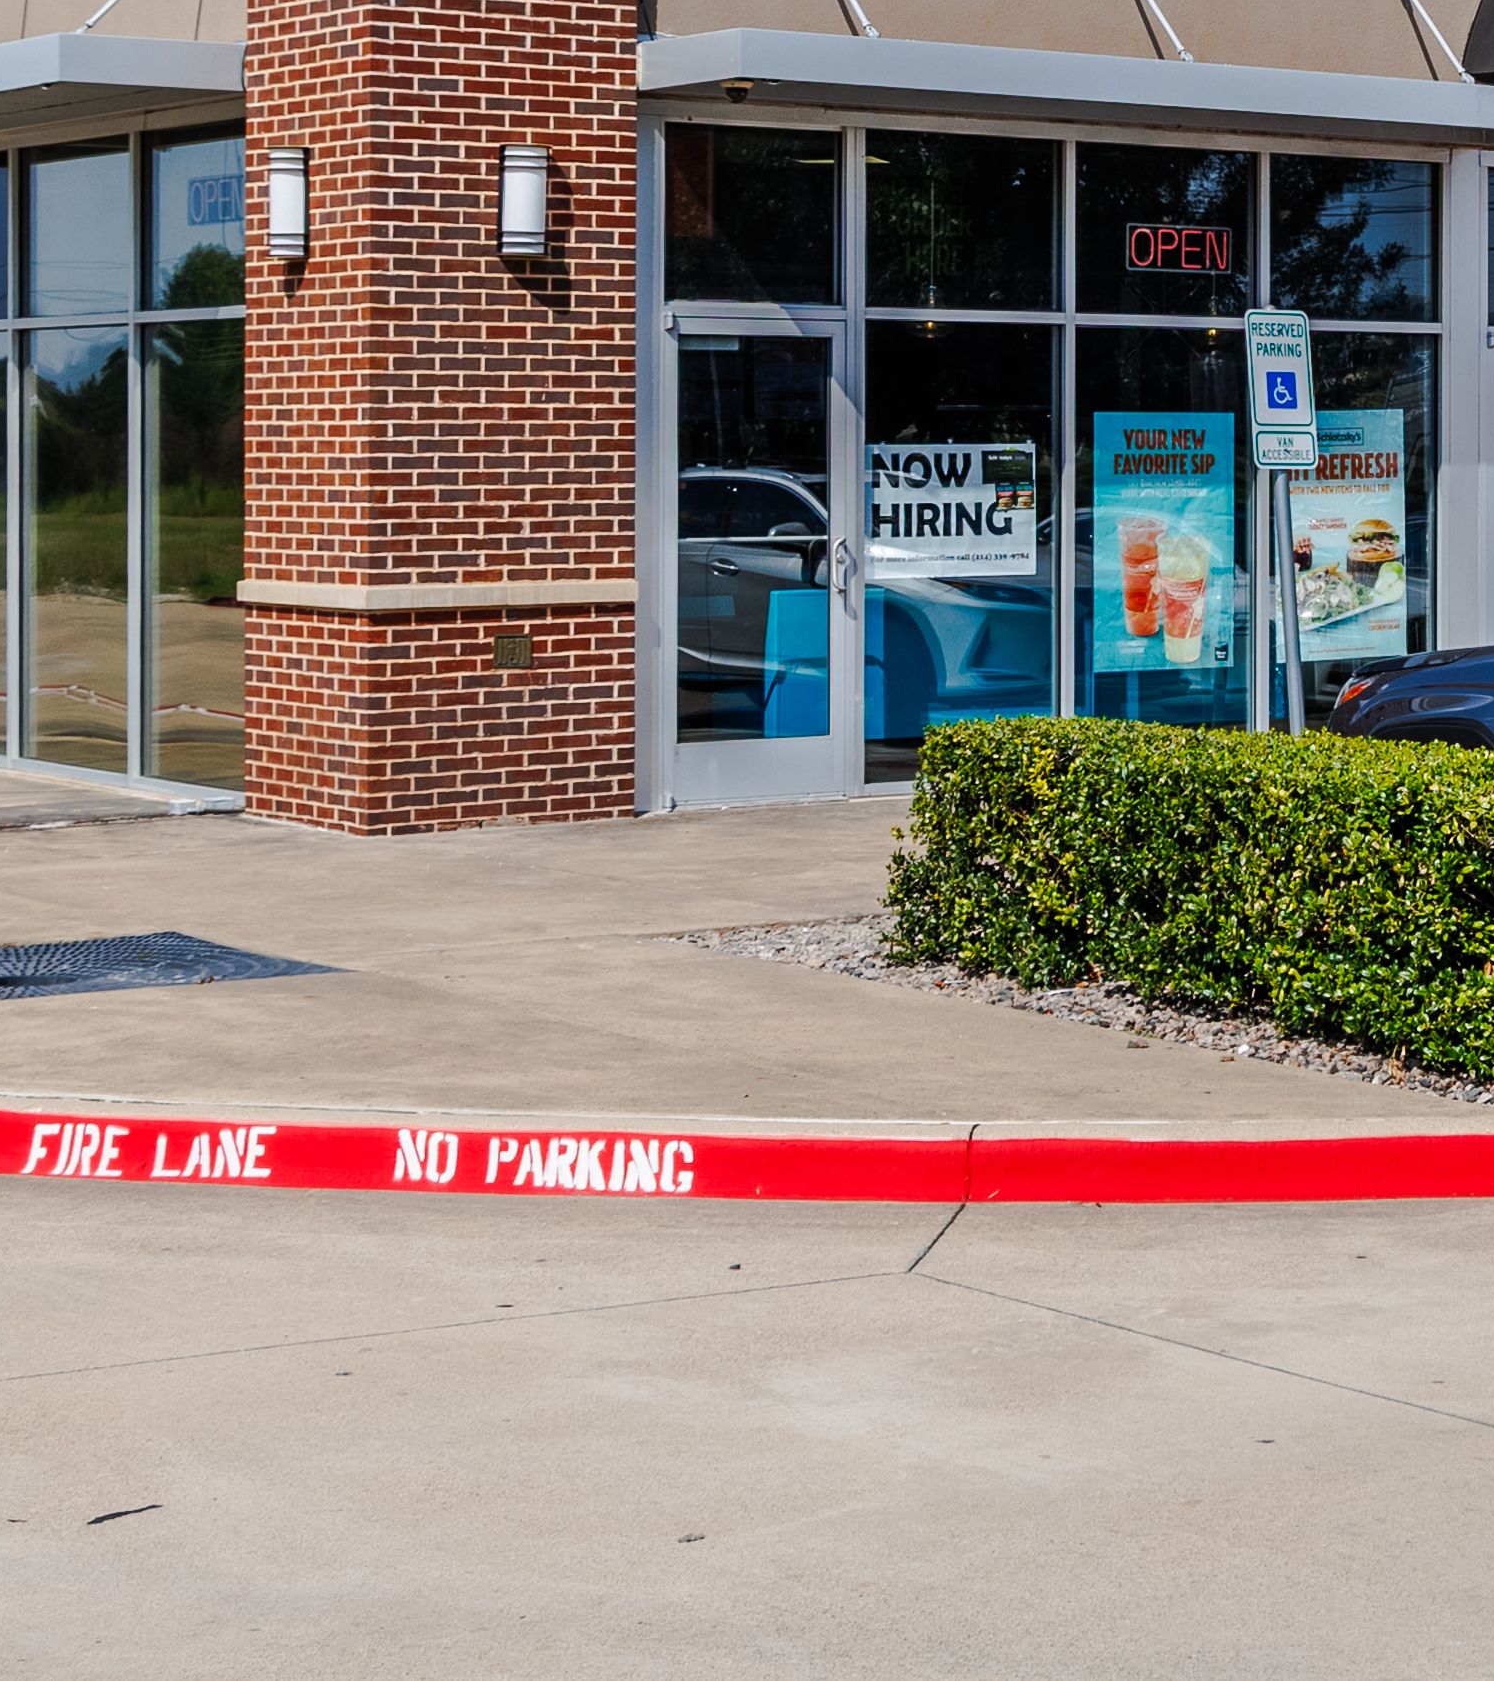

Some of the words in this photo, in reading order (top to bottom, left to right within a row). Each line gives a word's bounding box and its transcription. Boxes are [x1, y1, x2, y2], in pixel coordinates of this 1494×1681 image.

[1131, 227, 1227, 270] OPEN
[1251, 322, 1304, 338] RESERVED
[1256, 342, 1303, 358] PARKING
[1123, 428, 1169, 450] YOUR
[1171, 428, 1207, 450] NEW
[1276, 436, 1295, 448] VAN
[1113, 452, 1188, 475] FAVORITE
[1190, 452, 1216, 475] SIP
[1261, 449, 1312, 461] ACCESSIBLE
[1315, 452, 1399, 481] REFRESH
[871, 452, 973, 489] NOW
[871, 501, 1013, 538] HIRING
[21, 1122, 130, 1179] FIRE
[150, 1125, 277, 1179] LANE
[393, 1128, 459, 1185] NO
[485, 1136, 696, 1194] PARKING
